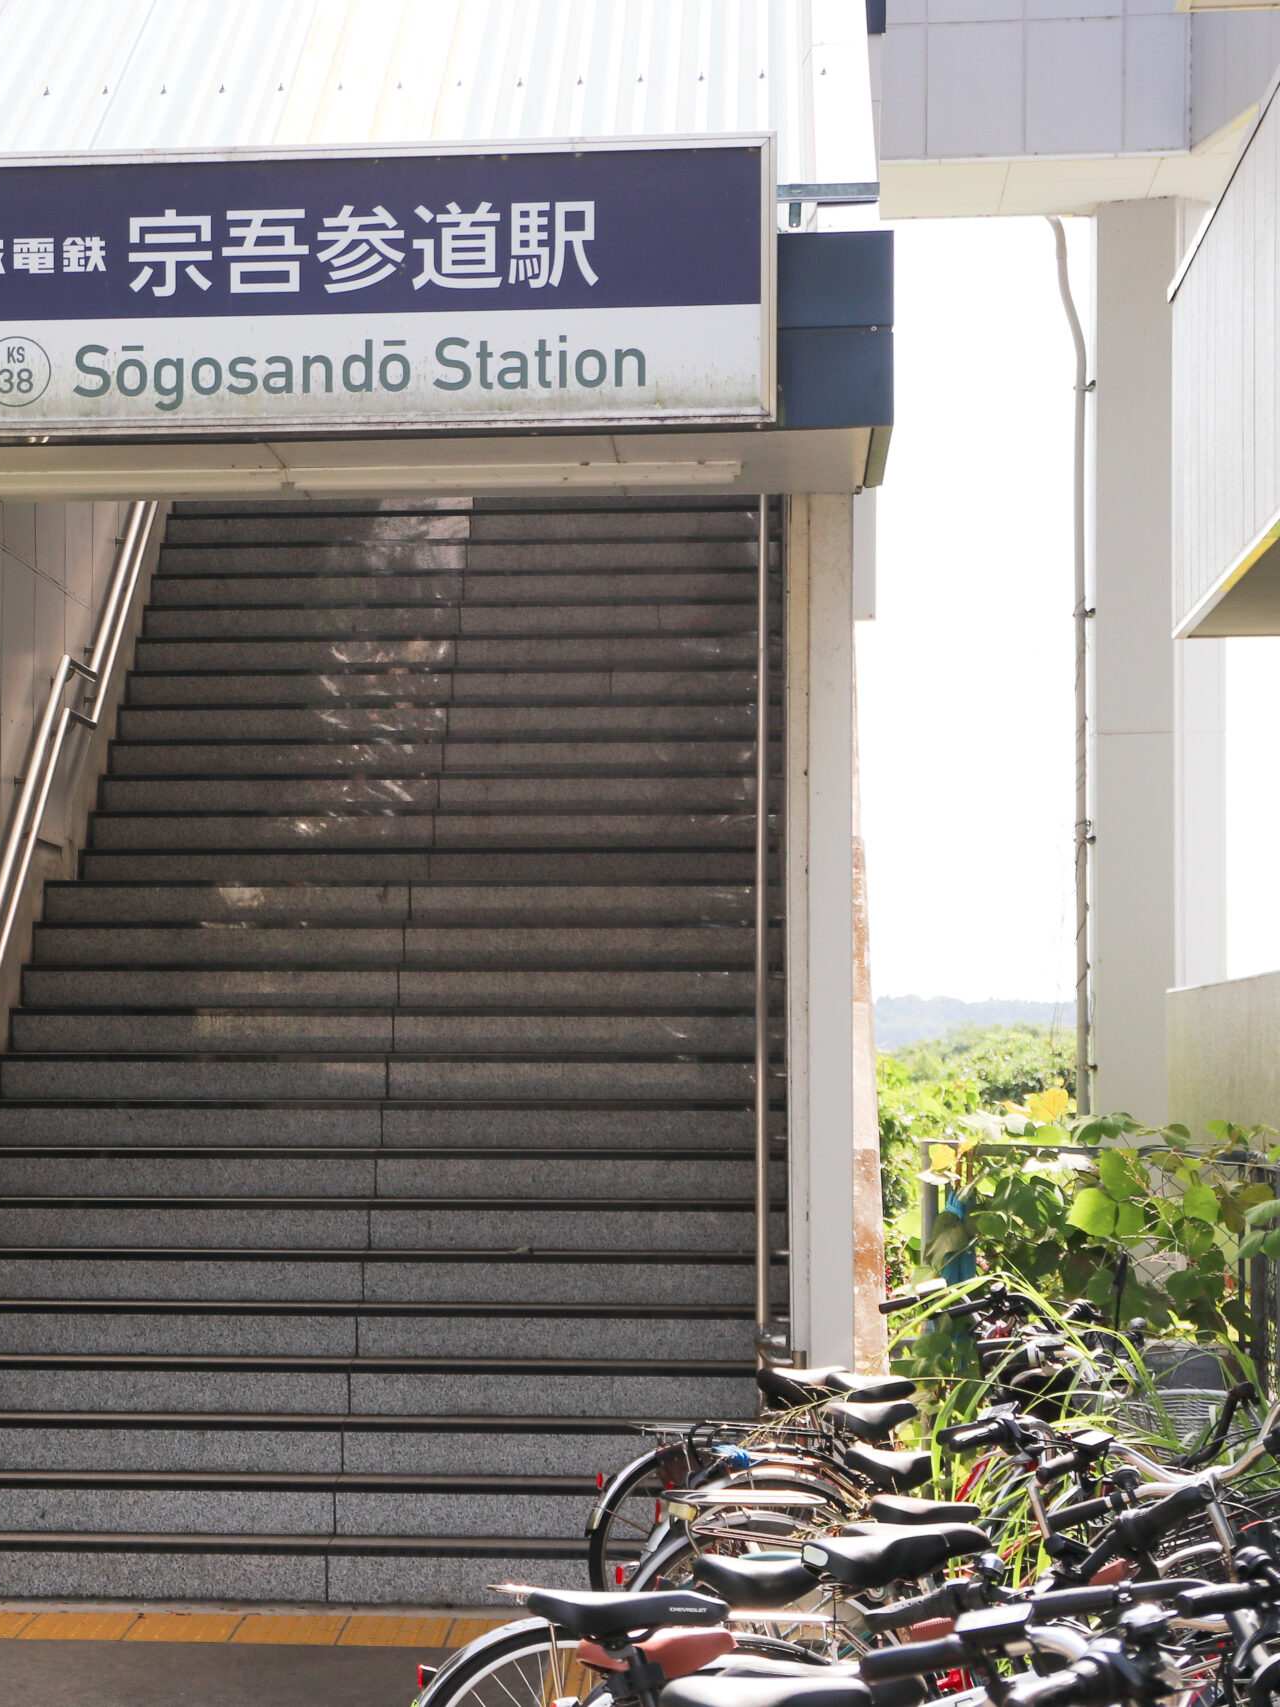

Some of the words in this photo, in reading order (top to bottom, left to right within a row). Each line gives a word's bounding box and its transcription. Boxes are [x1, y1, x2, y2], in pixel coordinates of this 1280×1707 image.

[128, 200, 599, 297] 宗吾参道駅
[7, 346, 25, 364] KS
[72, 339, 411, 411] Sōgosandō
[433, 335, 647, 391] Station
